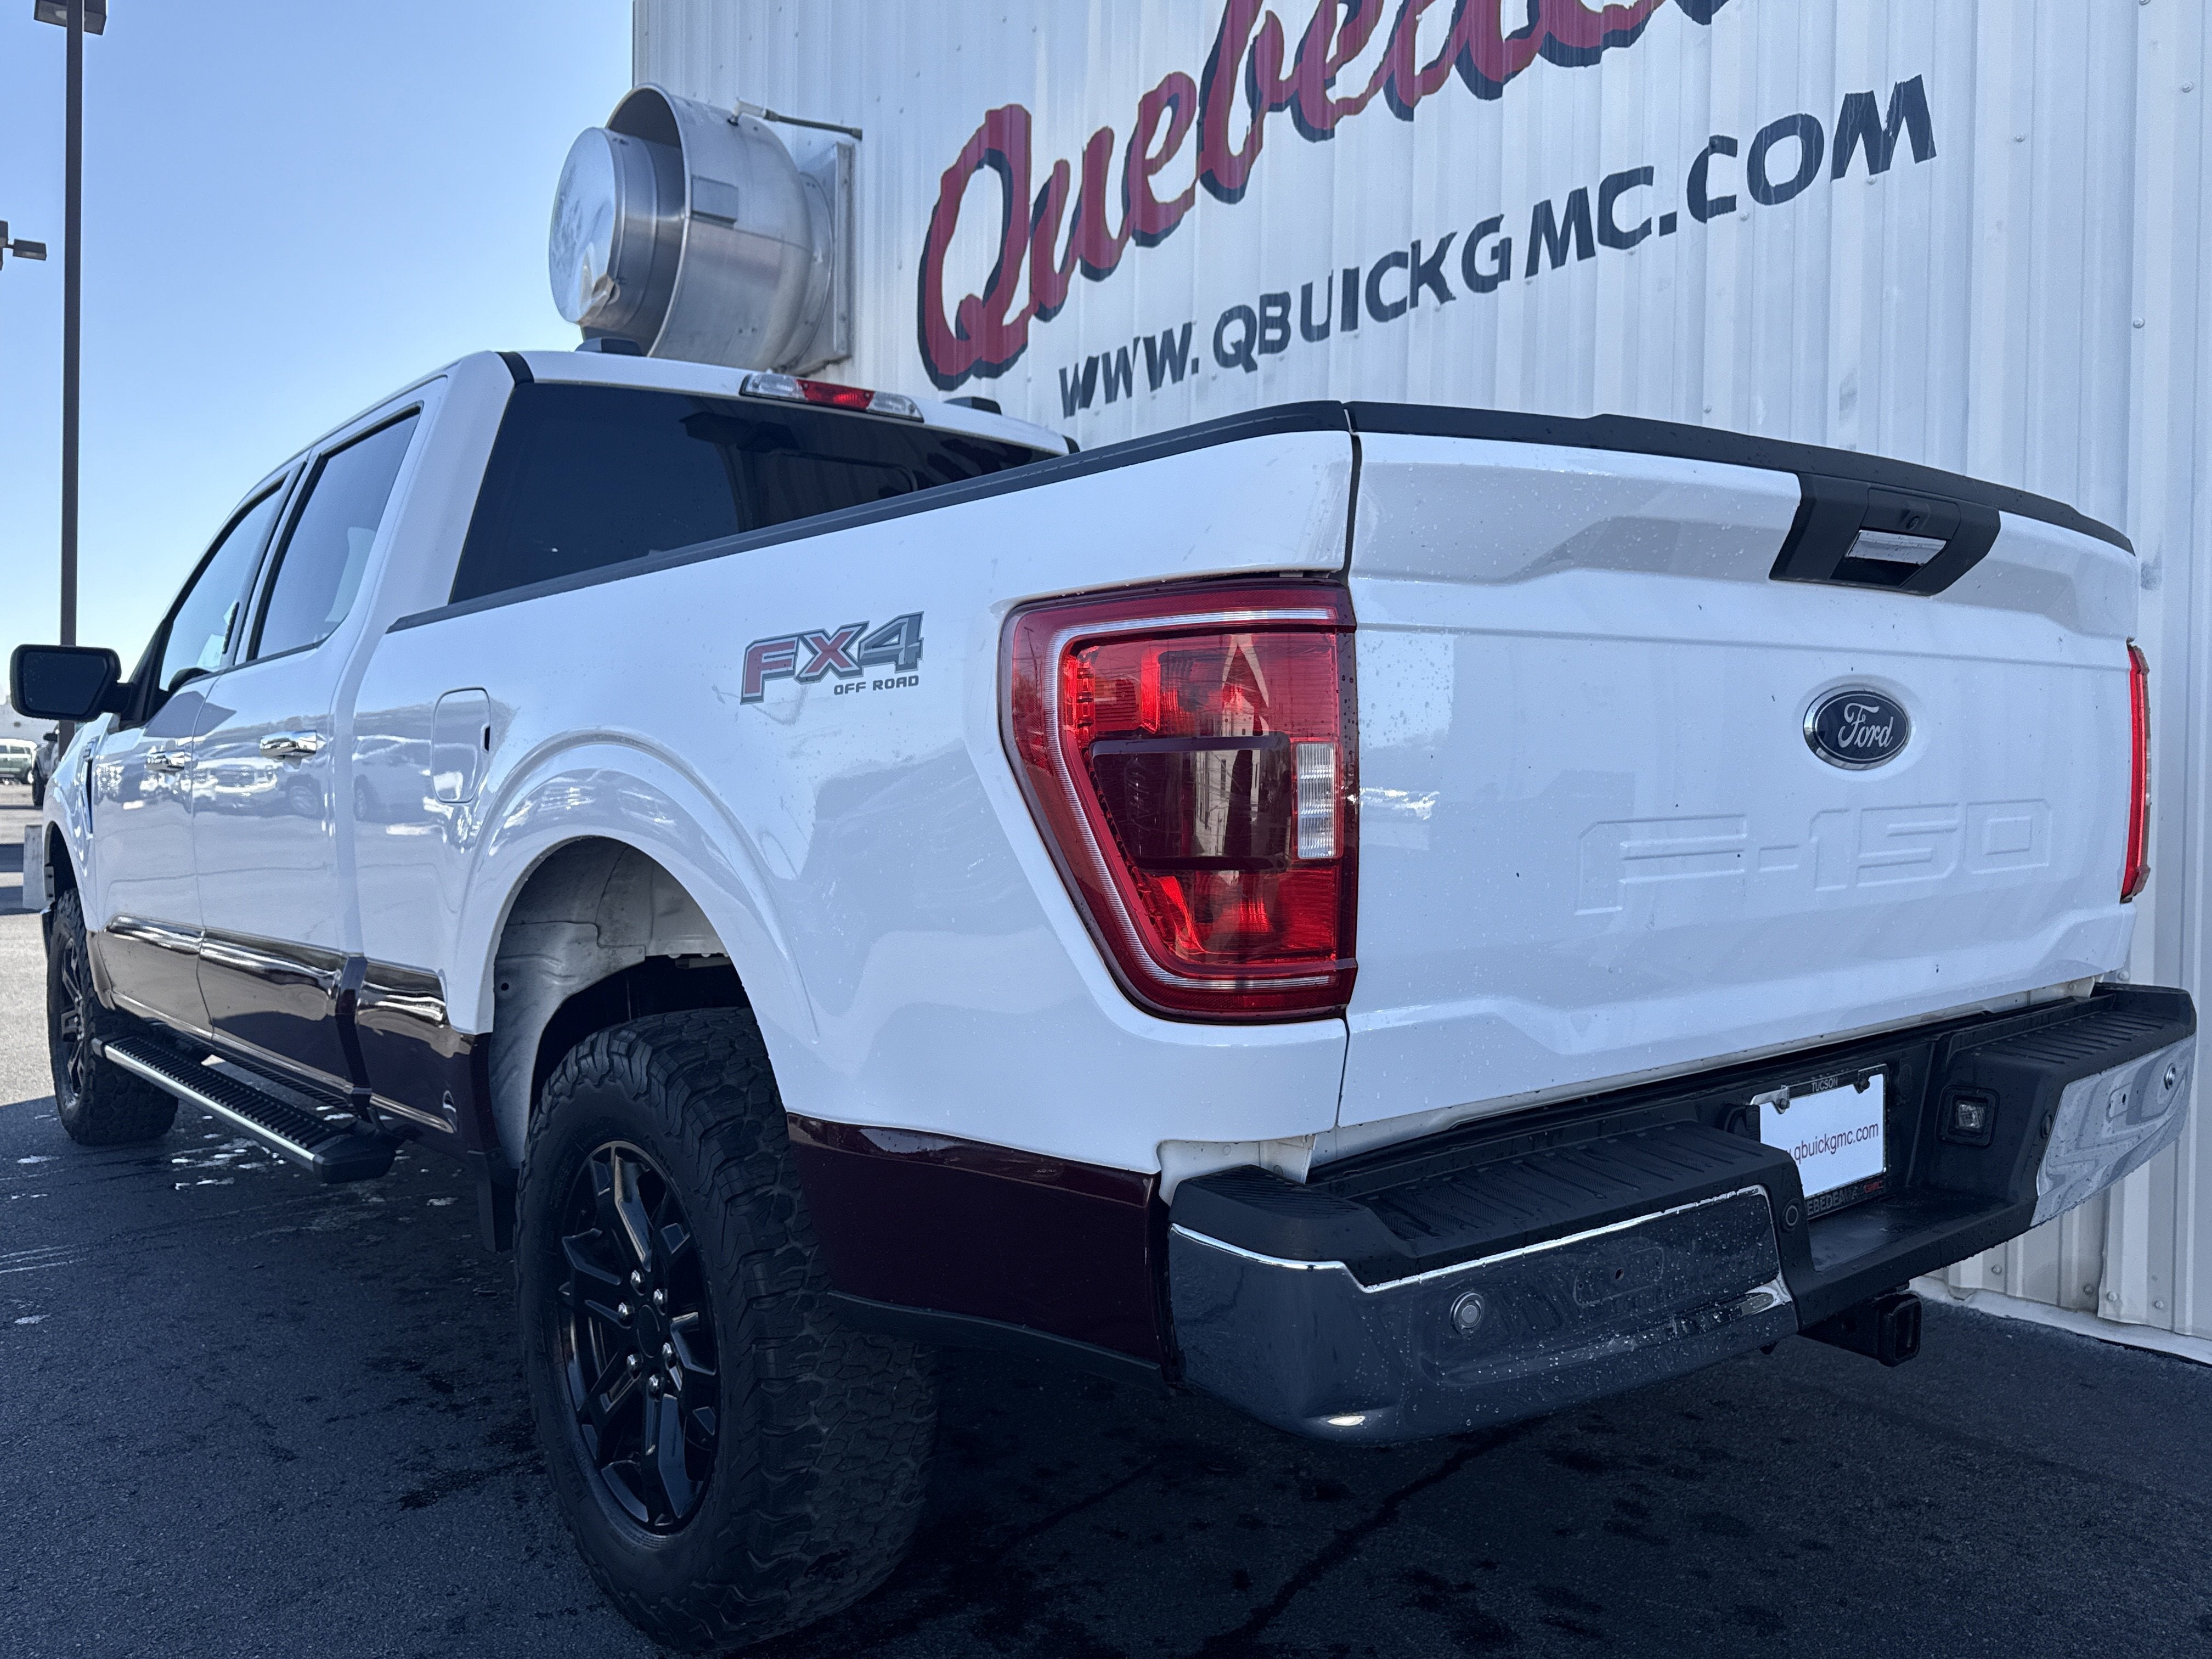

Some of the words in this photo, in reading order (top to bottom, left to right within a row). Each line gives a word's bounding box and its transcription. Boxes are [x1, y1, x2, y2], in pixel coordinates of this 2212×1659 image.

[740, 611, 924, 705] FX4
[834, 681, 866, 696] OFF
[872, 675, 919, 691] ROAD
[1838, 702, 1894, 748] Ford
[1573, 798, 2053, 916] F-150
[1811, 1076, 1838, 1093] TUCSON
[1786, 1123, 1879, 1165] qbuickgmc.com
